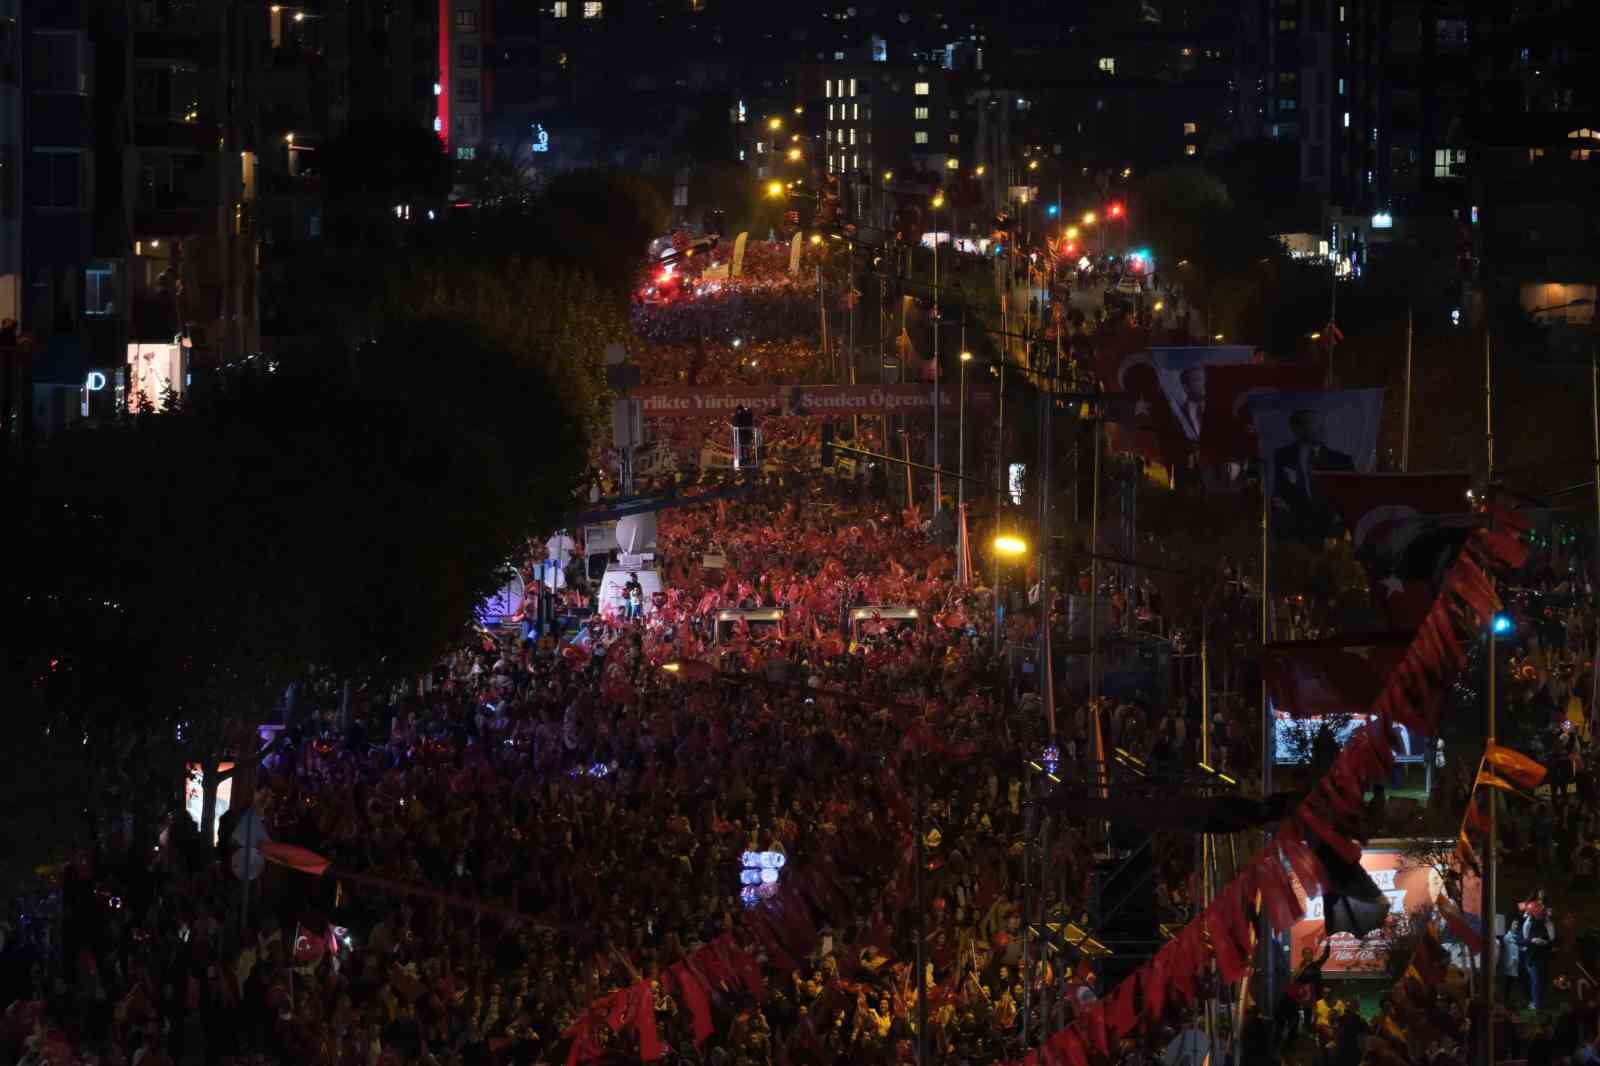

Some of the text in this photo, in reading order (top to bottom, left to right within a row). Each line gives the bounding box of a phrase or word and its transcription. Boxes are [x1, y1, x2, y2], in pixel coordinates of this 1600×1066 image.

[632, 394, 688, 409] rlikte
[800, 388, 951, 409] Senden Öğrendk
